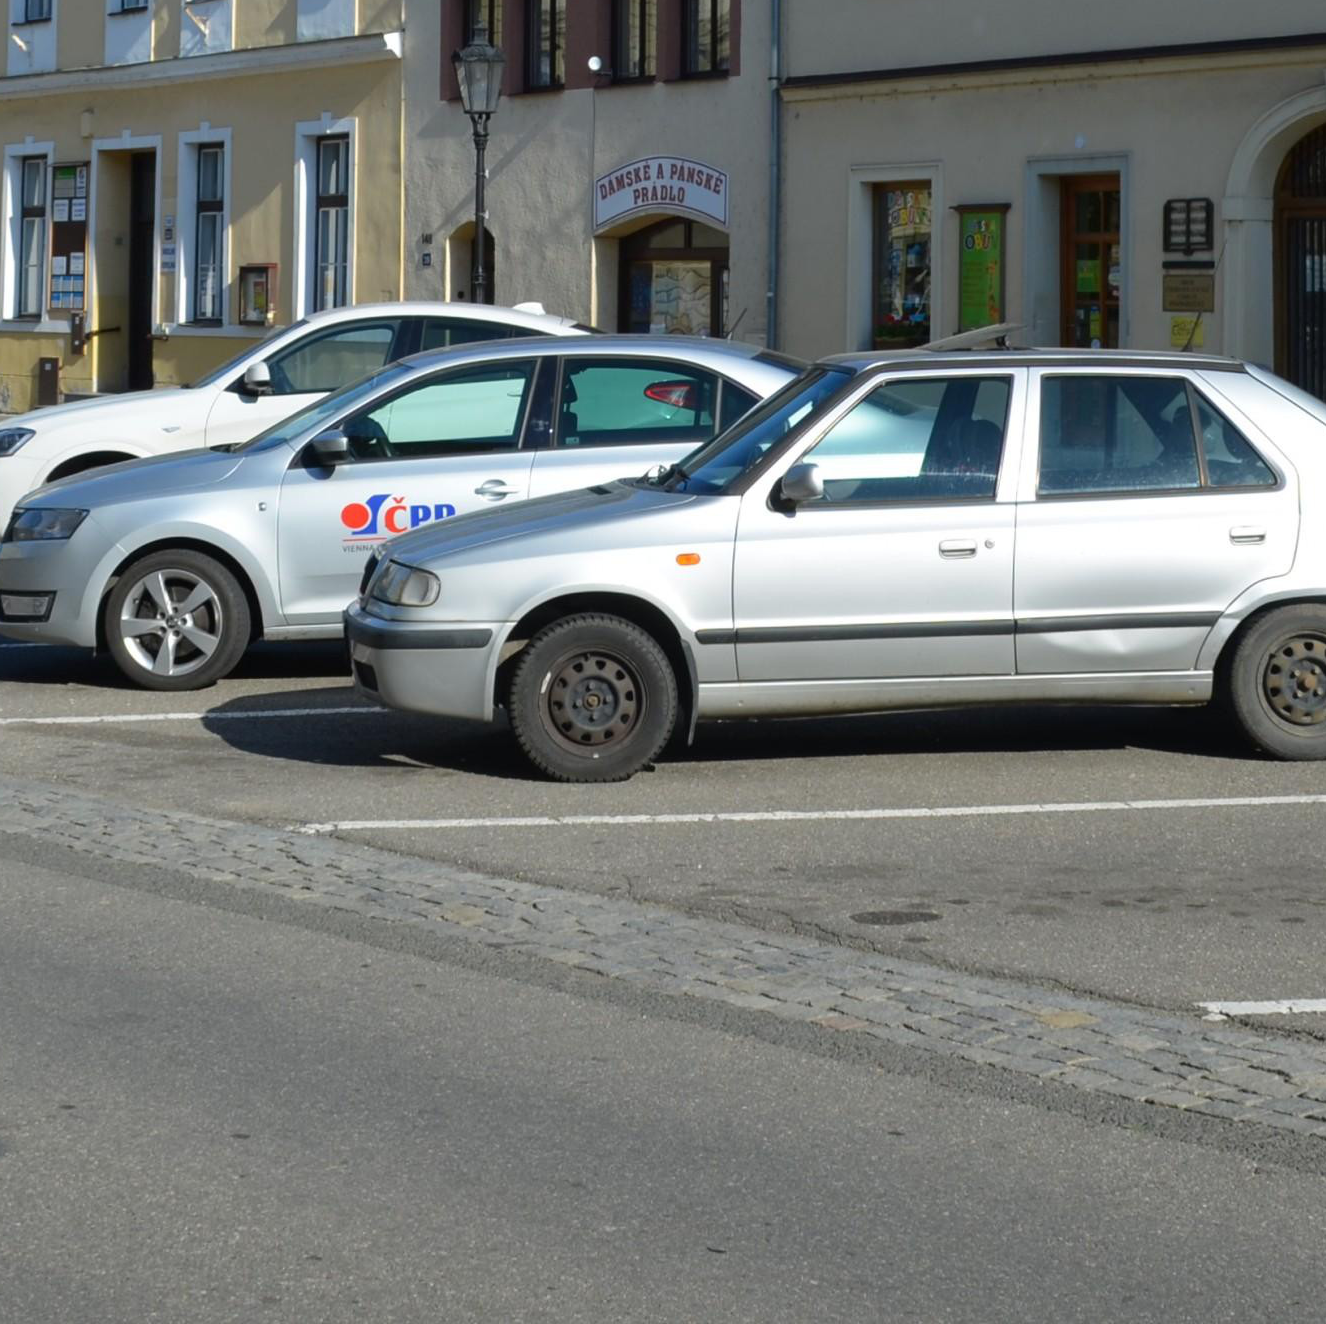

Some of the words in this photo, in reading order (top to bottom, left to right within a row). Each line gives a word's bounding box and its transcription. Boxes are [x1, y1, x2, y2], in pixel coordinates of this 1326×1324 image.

[599, 161, 651, 201] DÁMSKÉ
[656, 163, 664, 179] A
[670, 161, 724, 195] PÁNSKÉ
[633, 181, 686, 205] PRÁDLO
[384, 496, 456, 533] ČPP
